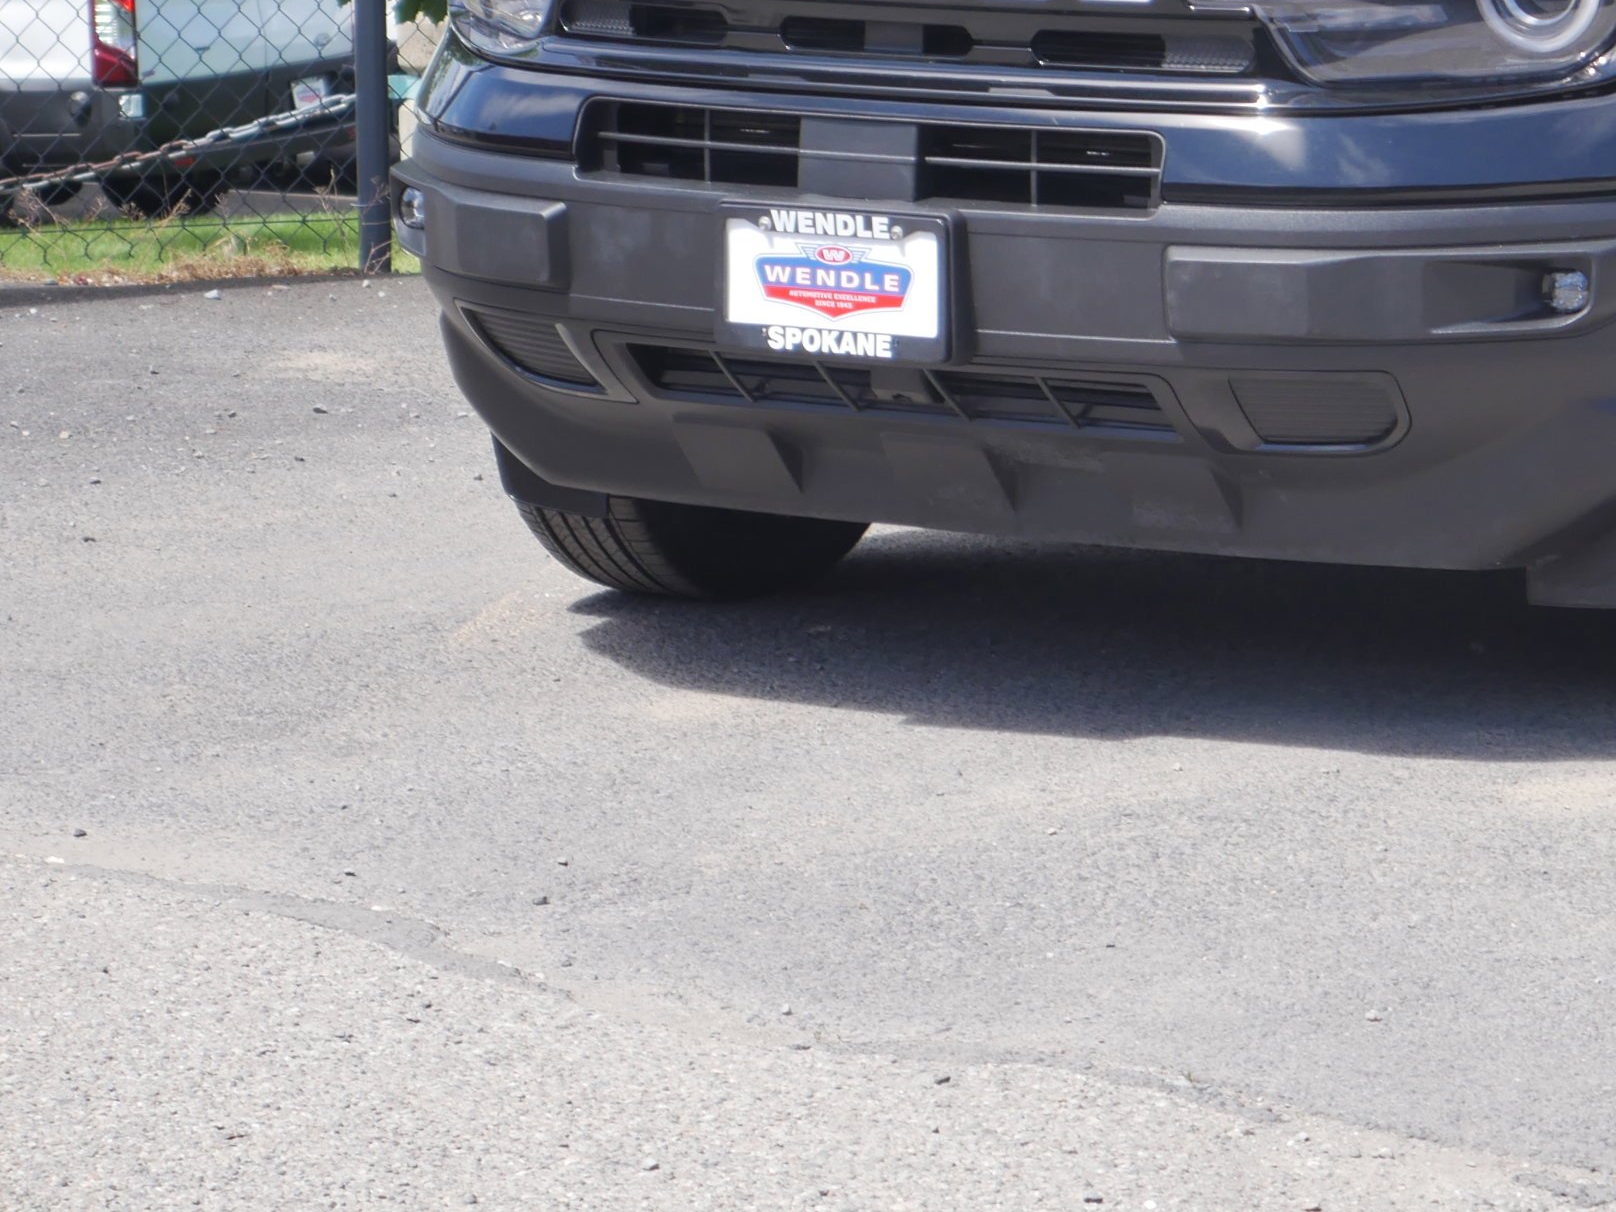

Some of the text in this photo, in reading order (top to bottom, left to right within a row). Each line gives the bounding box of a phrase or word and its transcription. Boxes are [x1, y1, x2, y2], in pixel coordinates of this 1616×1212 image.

[770, 209, 890, 239] WENDLE
[764, 264, 901, 292] WENDLE
[789, 290, 877, 303] AUTOMOTIVE EXCELLENCE
[815, 300, 835, 308] SINCE
[767, 326, 892, 358] SPOKANE
